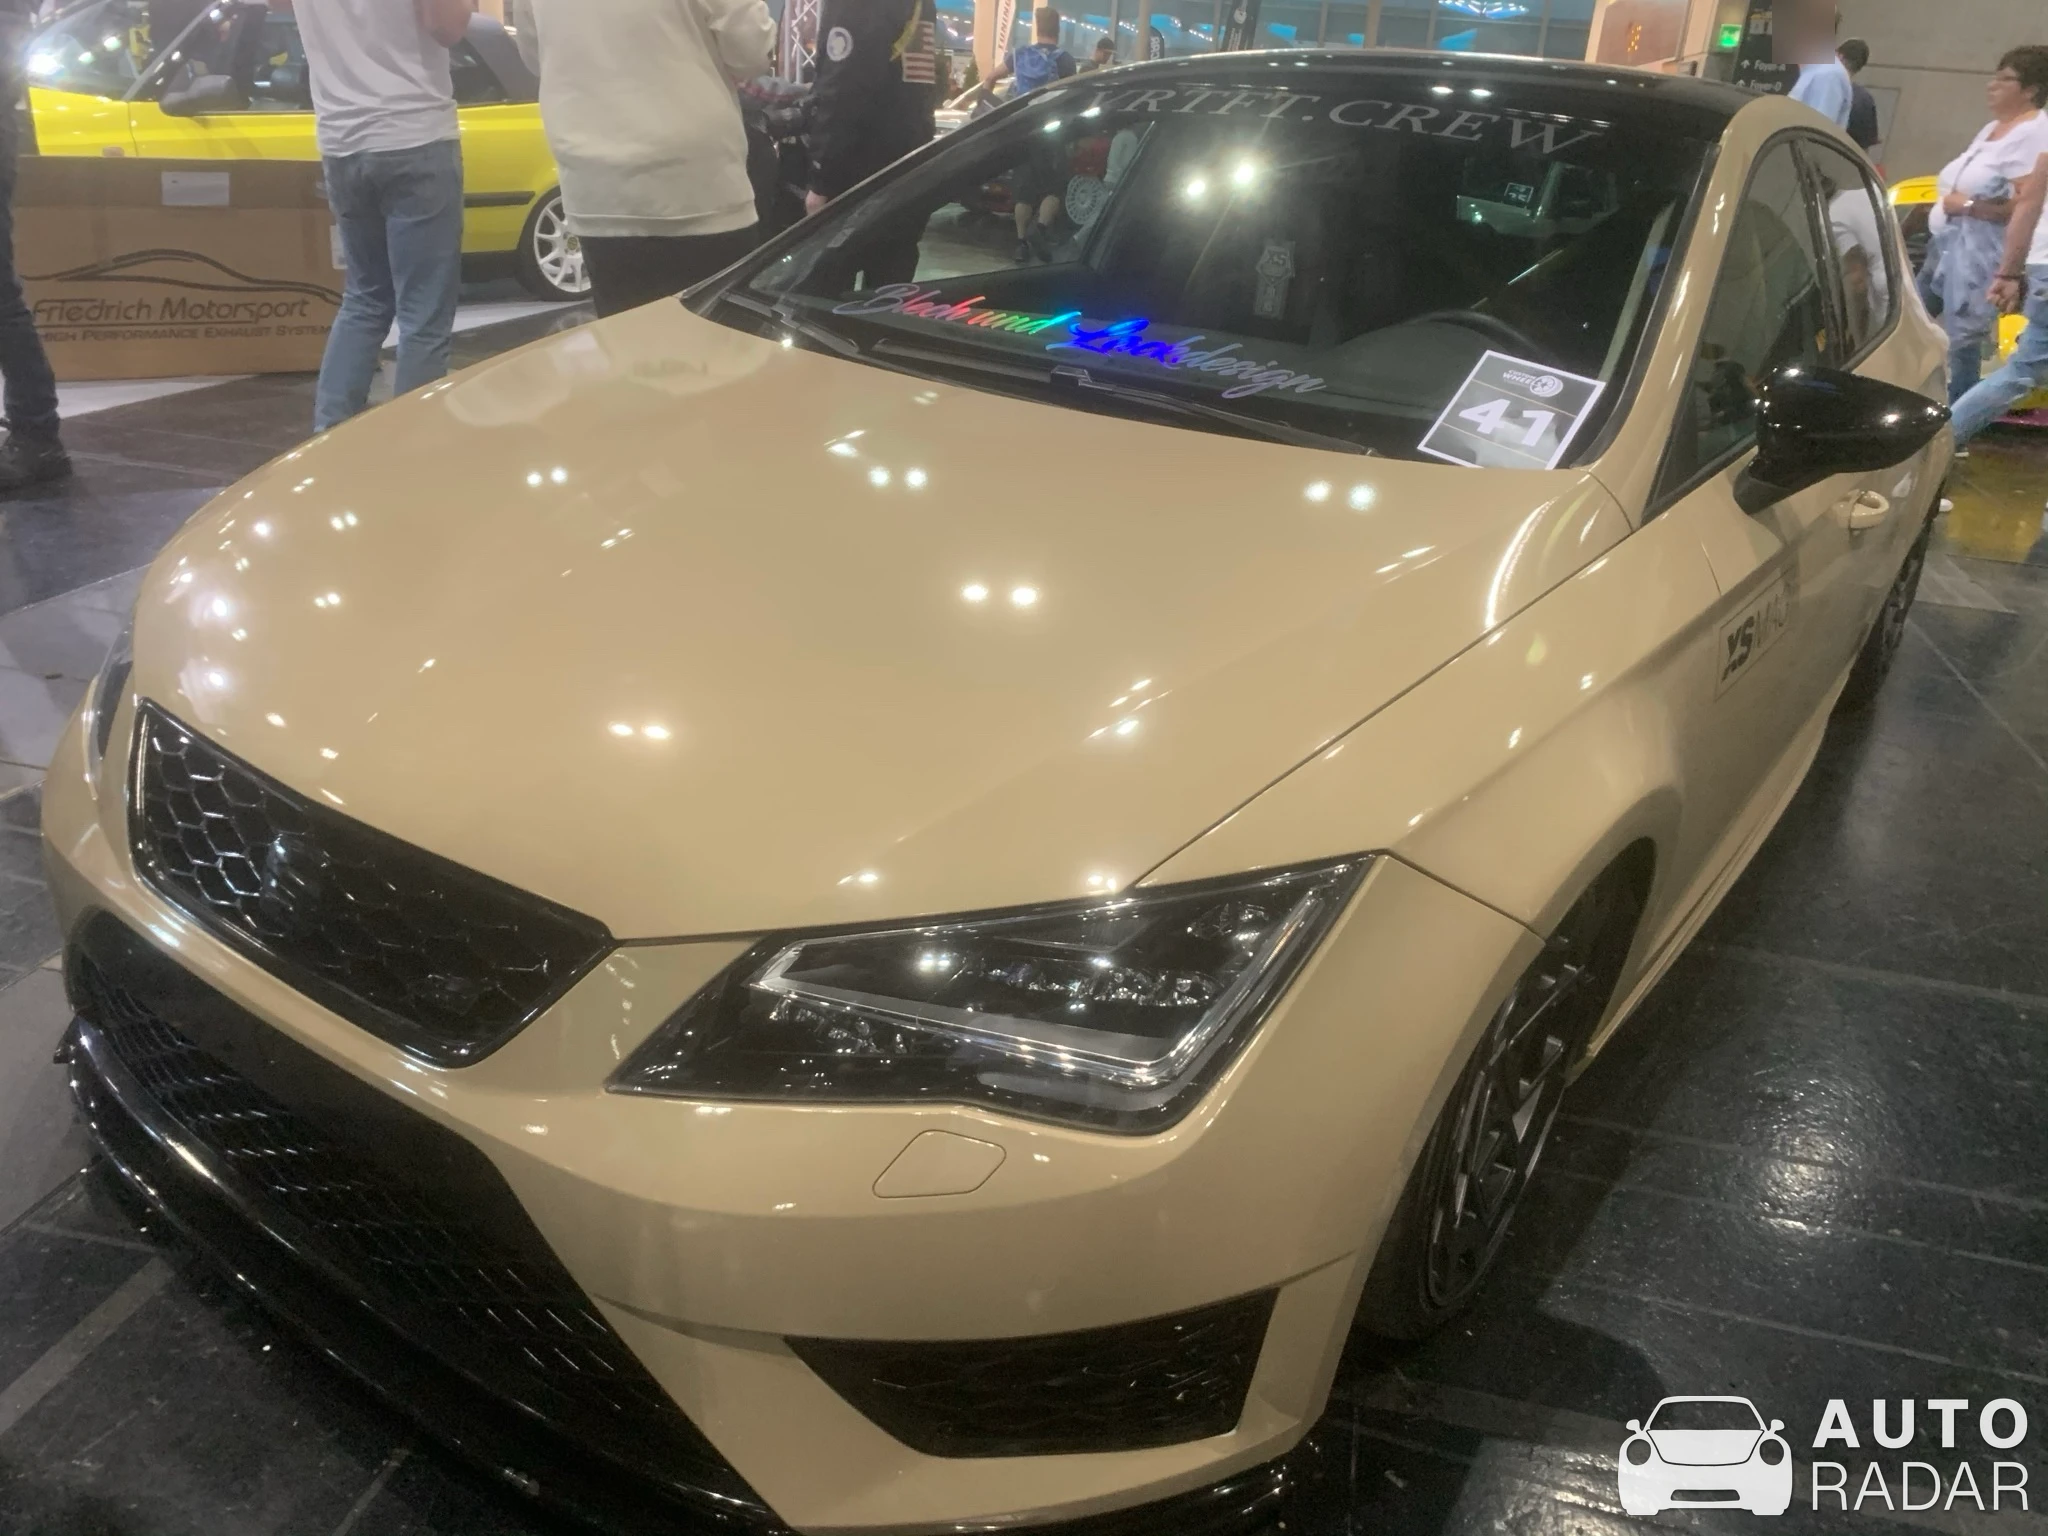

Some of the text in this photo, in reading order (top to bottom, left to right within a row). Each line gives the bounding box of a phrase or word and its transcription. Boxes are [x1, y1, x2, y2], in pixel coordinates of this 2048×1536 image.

[33, 297, 311, 324] Friedrich Motorsport
[832, 283, 986, 326] Blech
[968, 310, 1081, 335] und
[1458, 398, 1556, 447] 41
